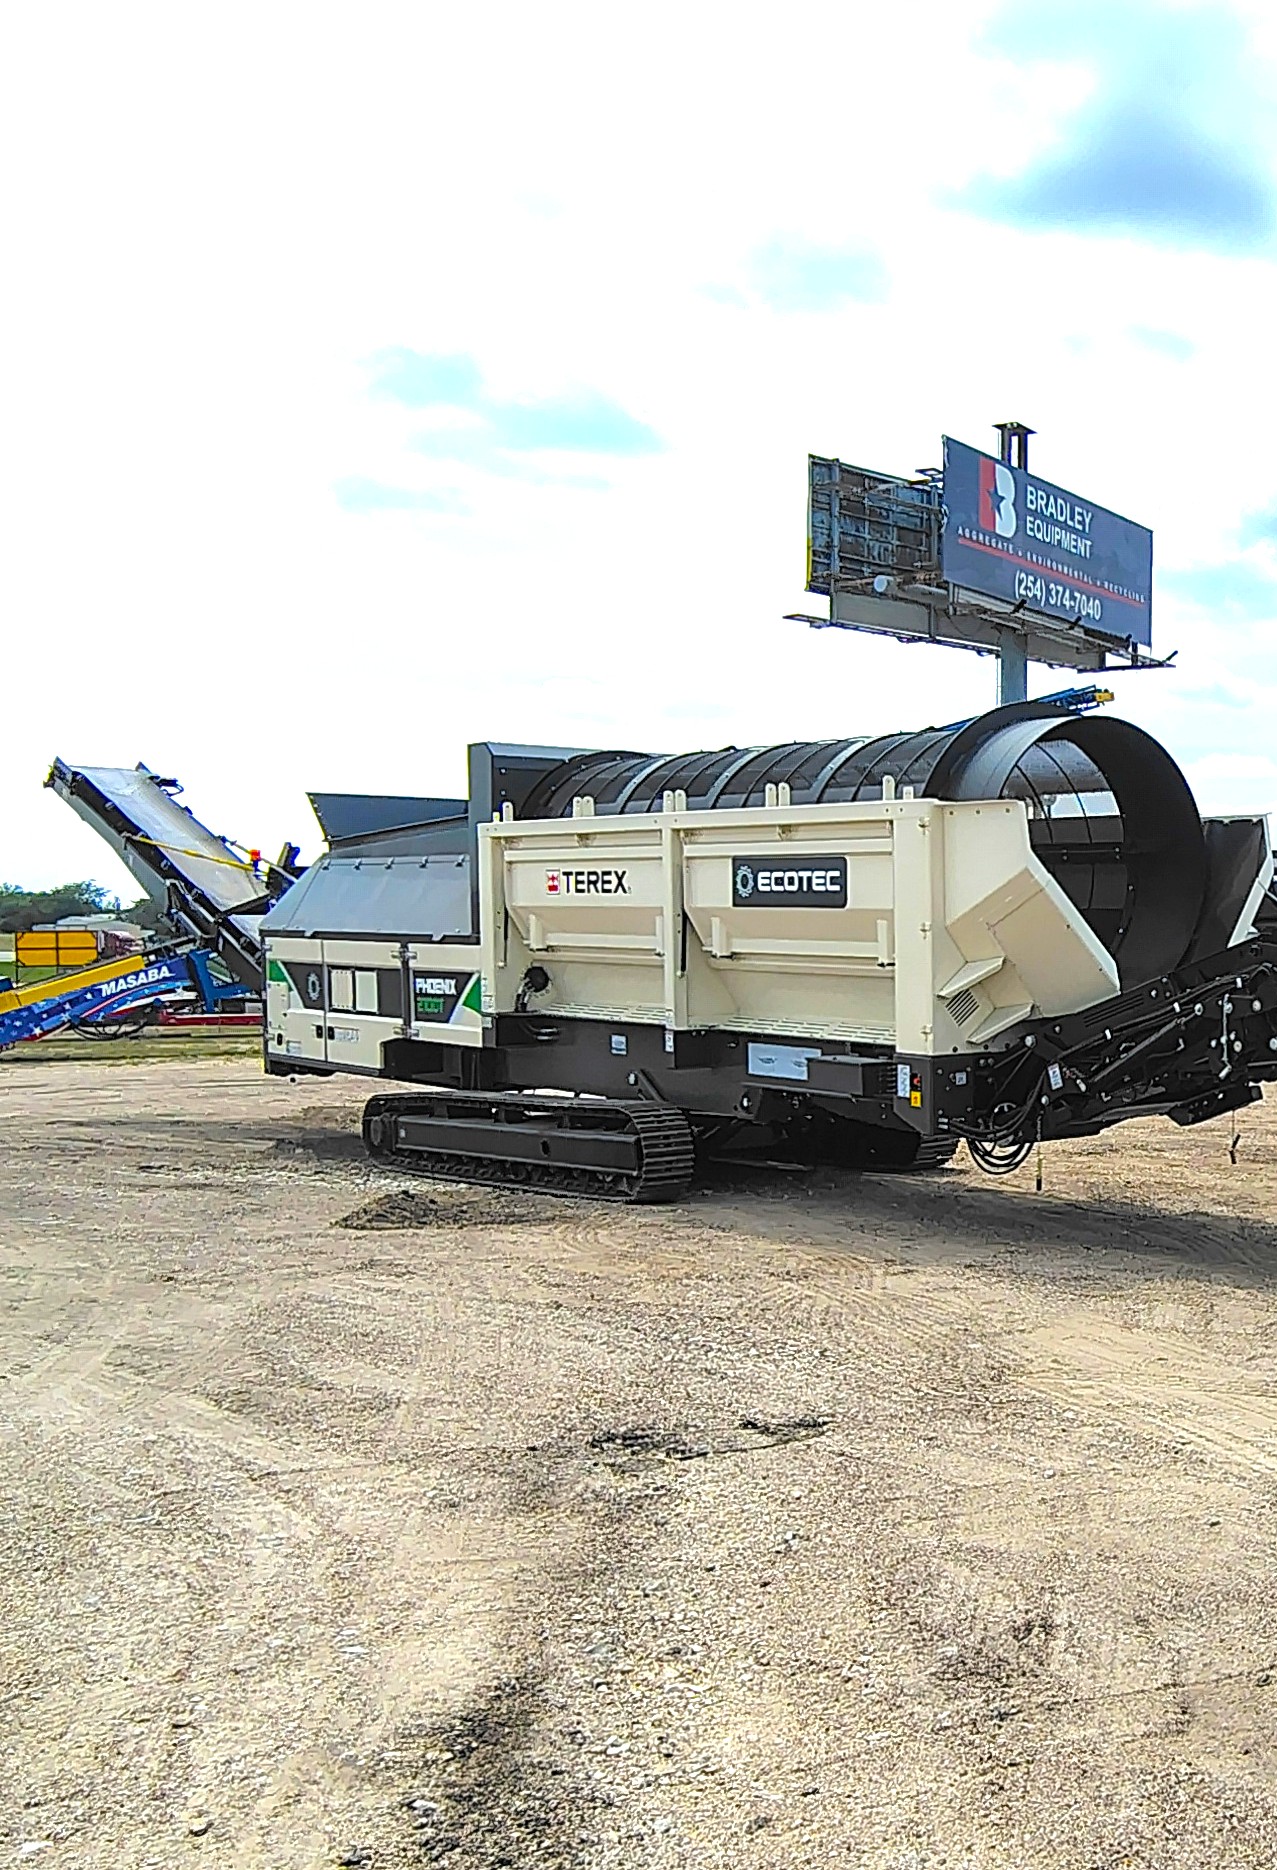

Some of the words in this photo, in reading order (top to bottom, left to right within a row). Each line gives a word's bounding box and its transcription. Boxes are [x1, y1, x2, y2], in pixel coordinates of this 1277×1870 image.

[1026, 483, 1092, 534] BRADLEY
[1026, 515, 1092, 560] EQUIPMENT
[957, 525, 1014, 555] AGGREGATE
[1026, 551, 1093, 585] ENVIRONMENTAL
[1103, 581, 1145, 604] RECYCLING
[1014, 569, 1046, 608] (254)
[1049, 582, 1102, 621] 374-7040
[562, 870, 627, 894] TEREX
[757, 870, 841, 892] ECOTEC
[94, 965, 176, 998] MASABA
[415, 978, 457, 995] PHOENIX
